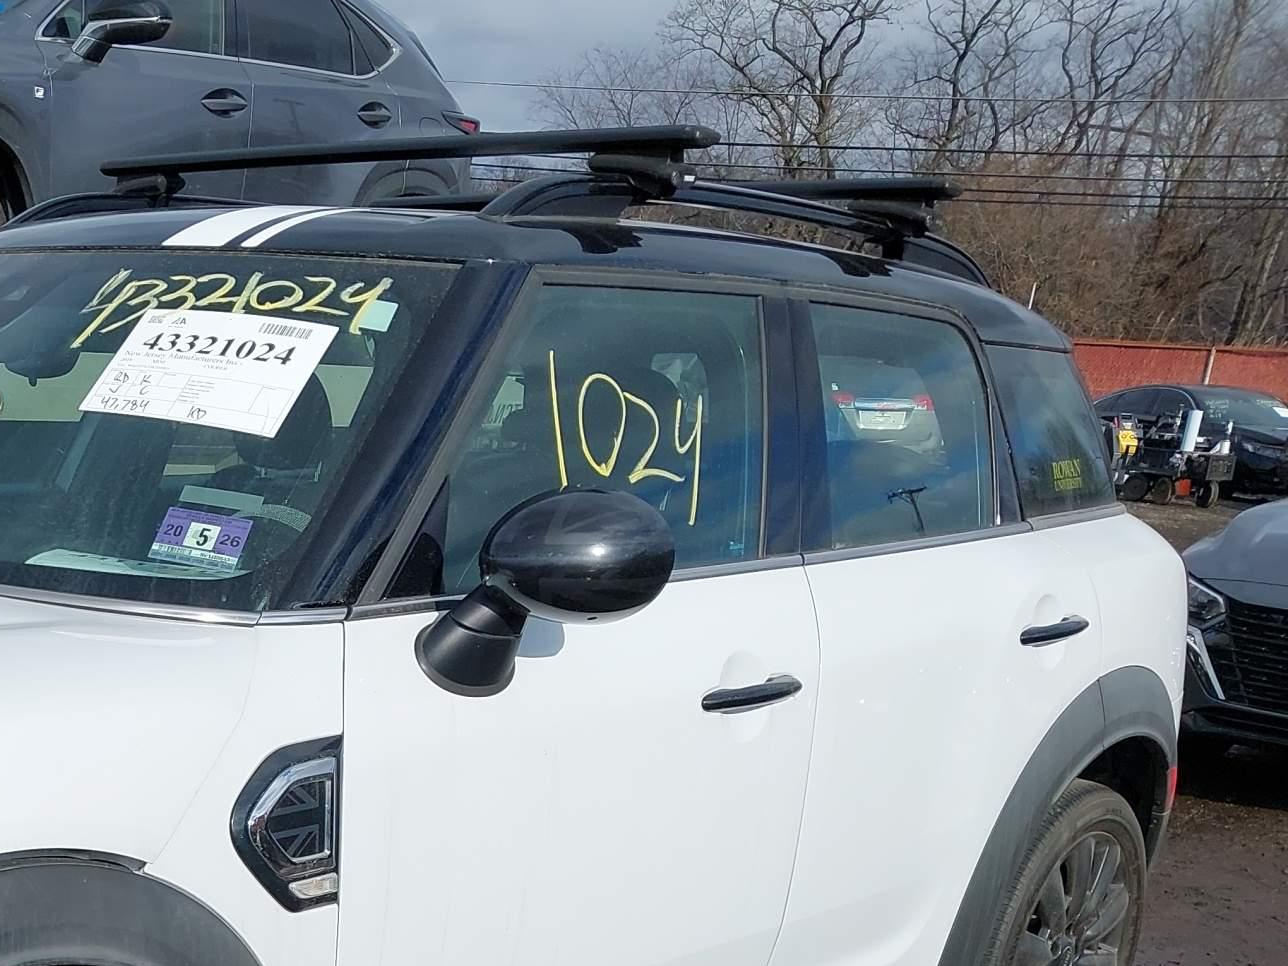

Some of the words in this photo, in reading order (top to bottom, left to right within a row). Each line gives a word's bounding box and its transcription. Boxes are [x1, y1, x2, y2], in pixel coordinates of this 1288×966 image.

[70, 268, 393, 348] 43321024
[142, 332, 297, 365] 43321024
[549, 350, 703, 526] 1024
[1051, 458, 1081, 480] ROWAN
[164, 524, 184, 537] 20
[196, 528, 212, 546] 5
[219, 534, 241, 547] 26
